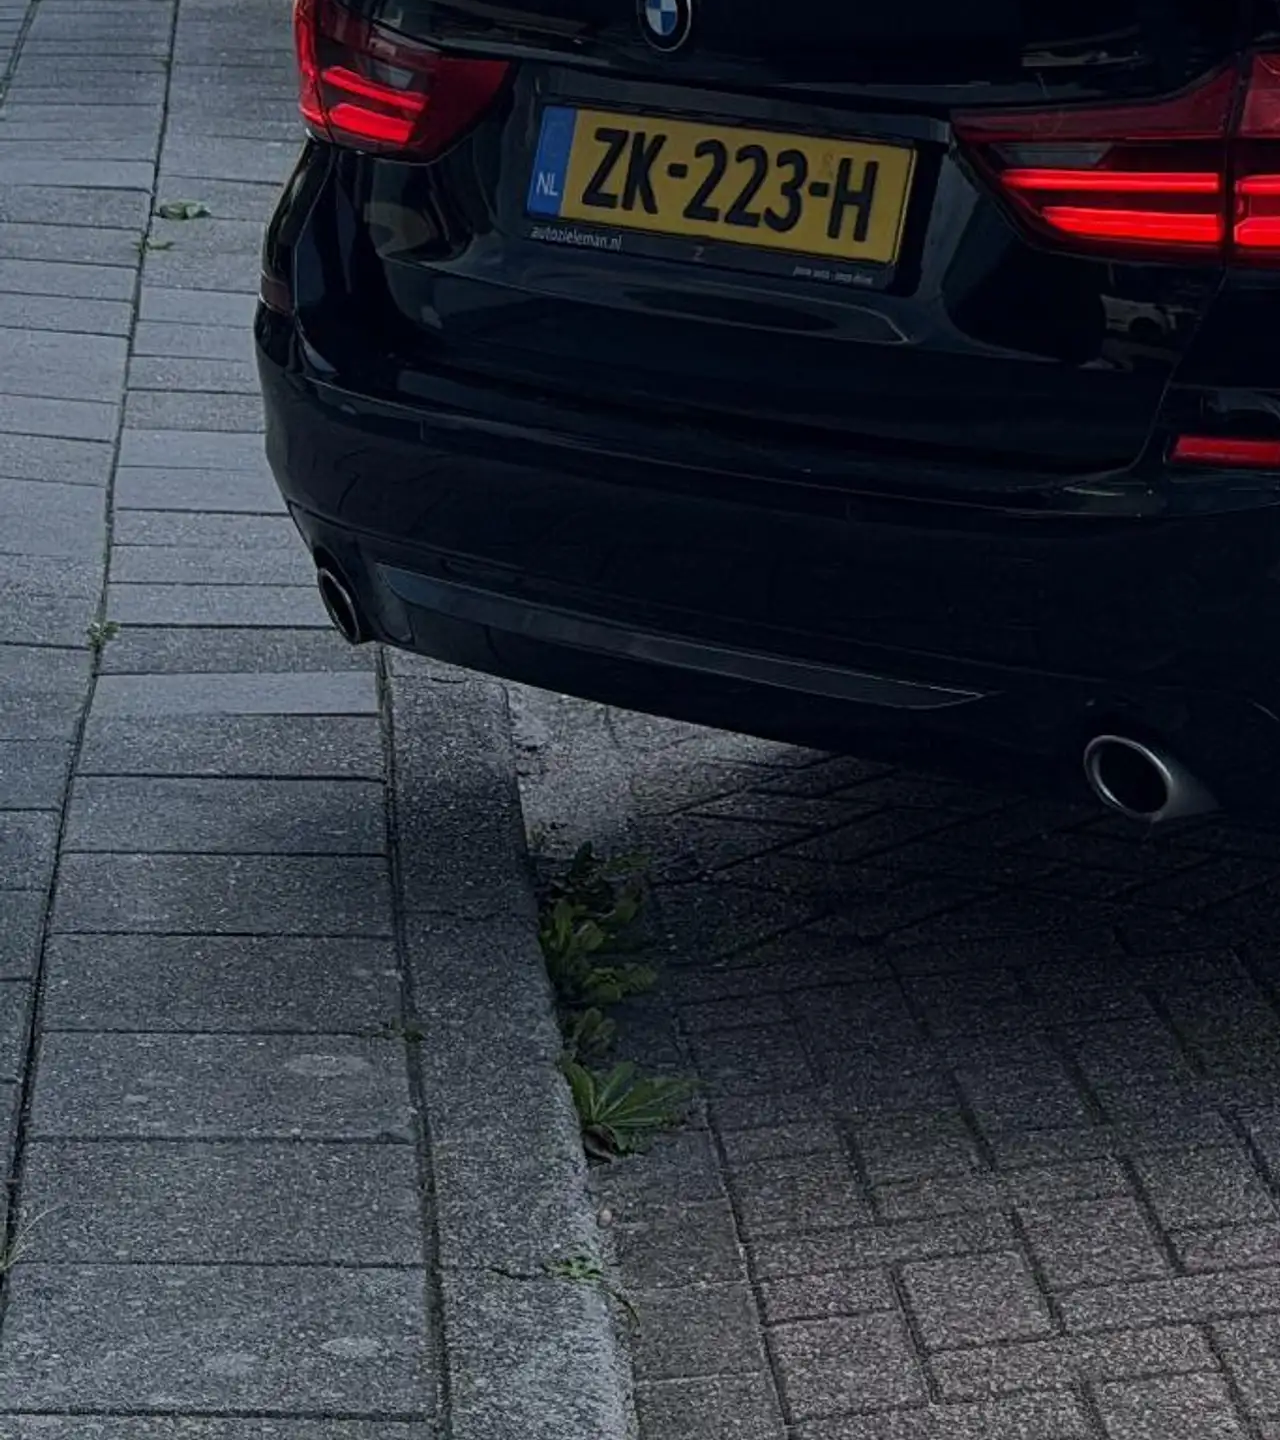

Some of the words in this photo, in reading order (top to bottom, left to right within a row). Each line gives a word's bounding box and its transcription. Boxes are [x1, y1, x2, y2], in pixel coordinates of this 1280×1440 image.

[536, 171, 558, 197] NL
[581, 127, 880, 242] ZK-223-H
[530, 225, 622, 251] autozieleman.nl
